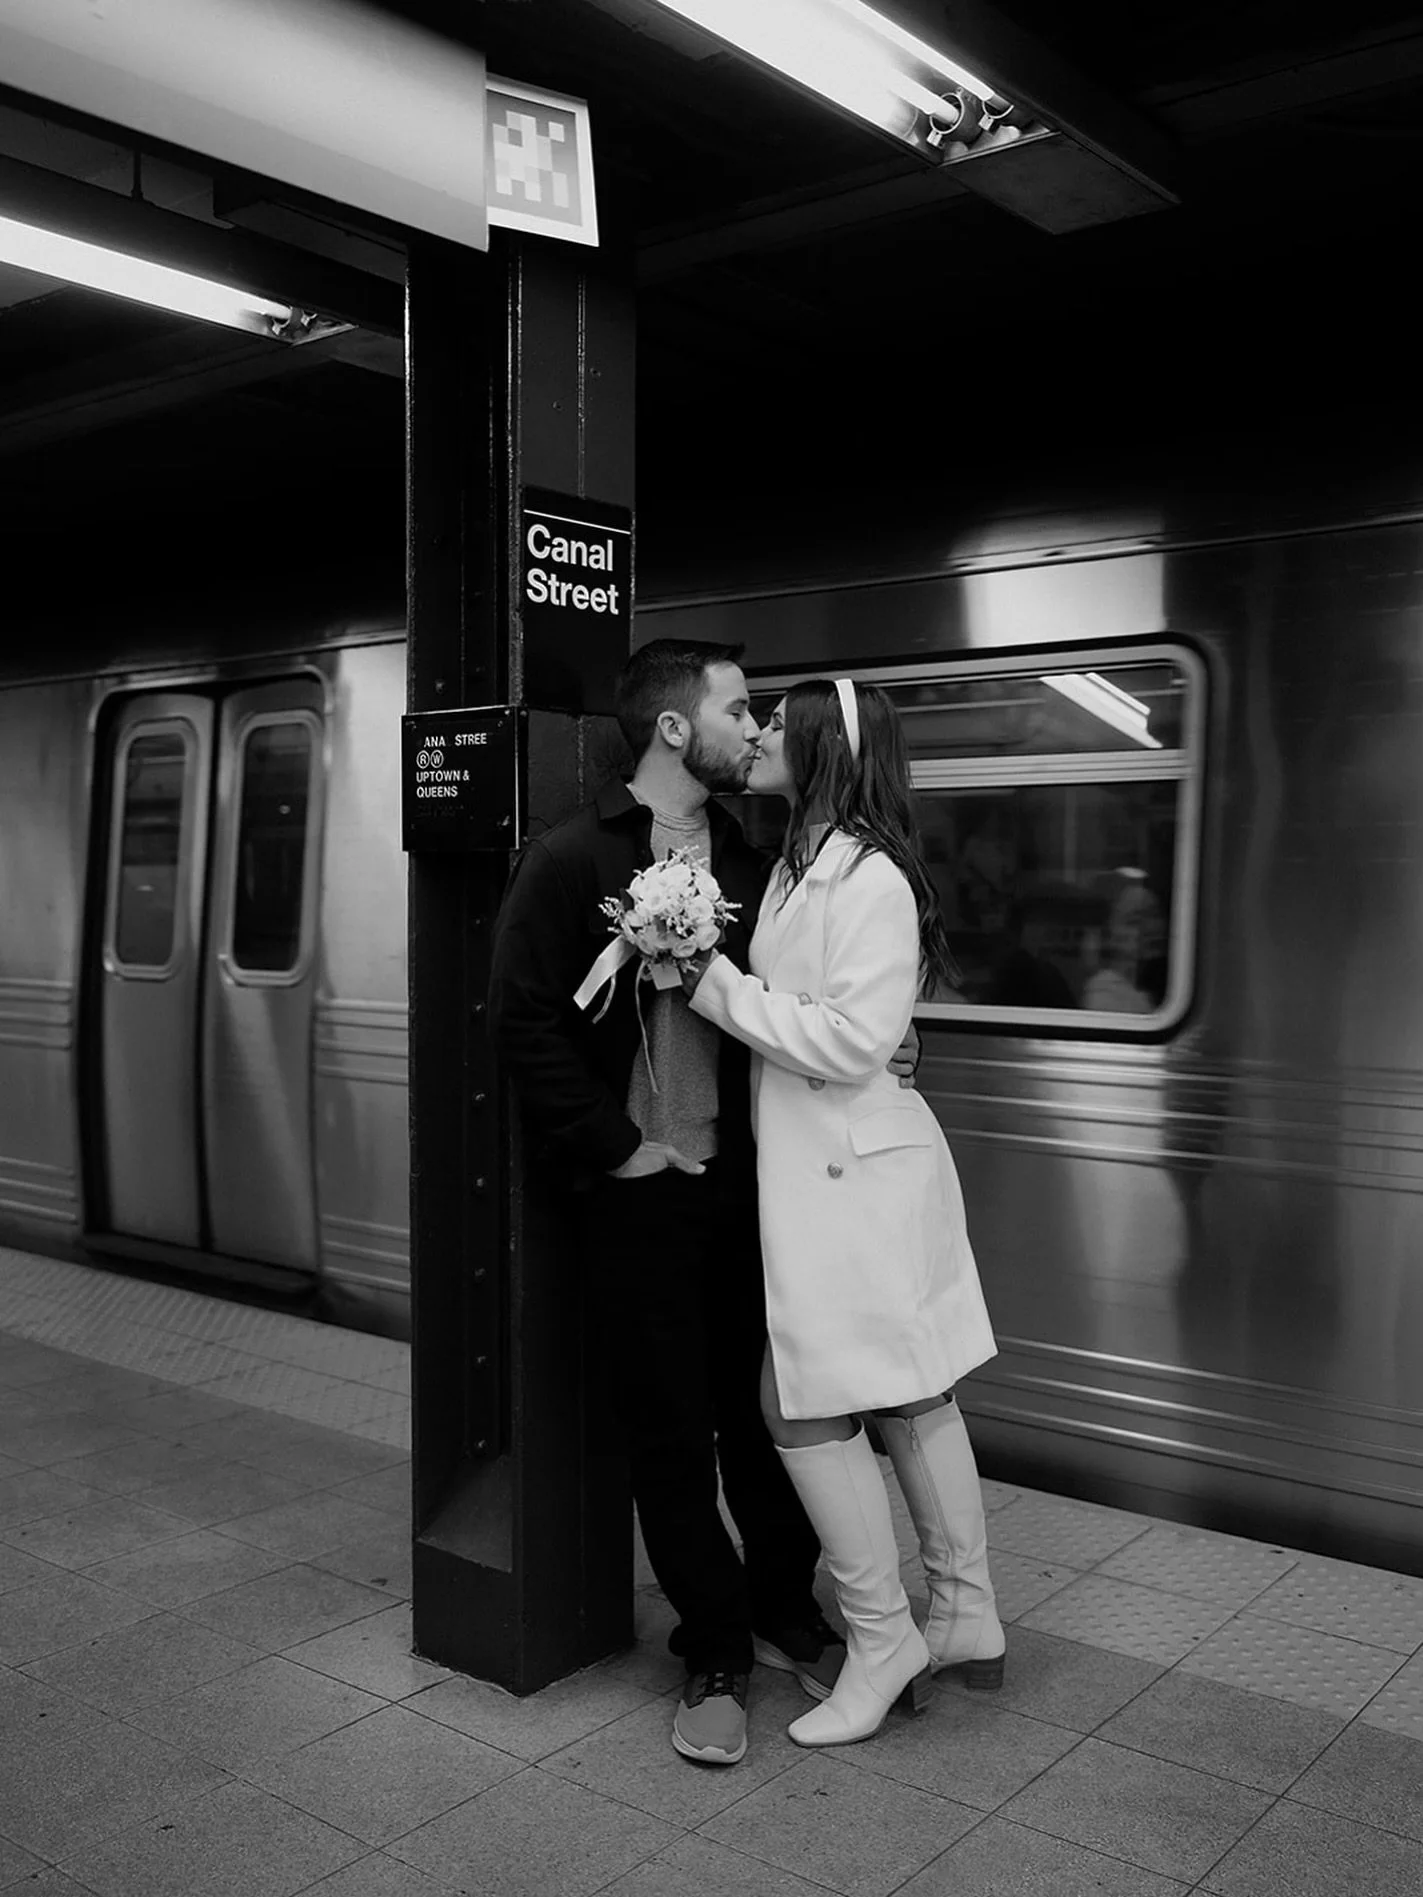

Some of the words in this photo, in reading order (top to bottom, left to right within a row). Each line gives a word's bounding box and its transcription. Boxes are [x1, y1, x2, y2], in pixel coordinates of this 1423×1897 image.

[527, 523, 614, 572] Canal
[526, 567, 619, 615] Street
[415, 769, 461, 783] UPTOWN
[462, 769, 471, 782] &
[416, 785, 459, 799] QUEENS
